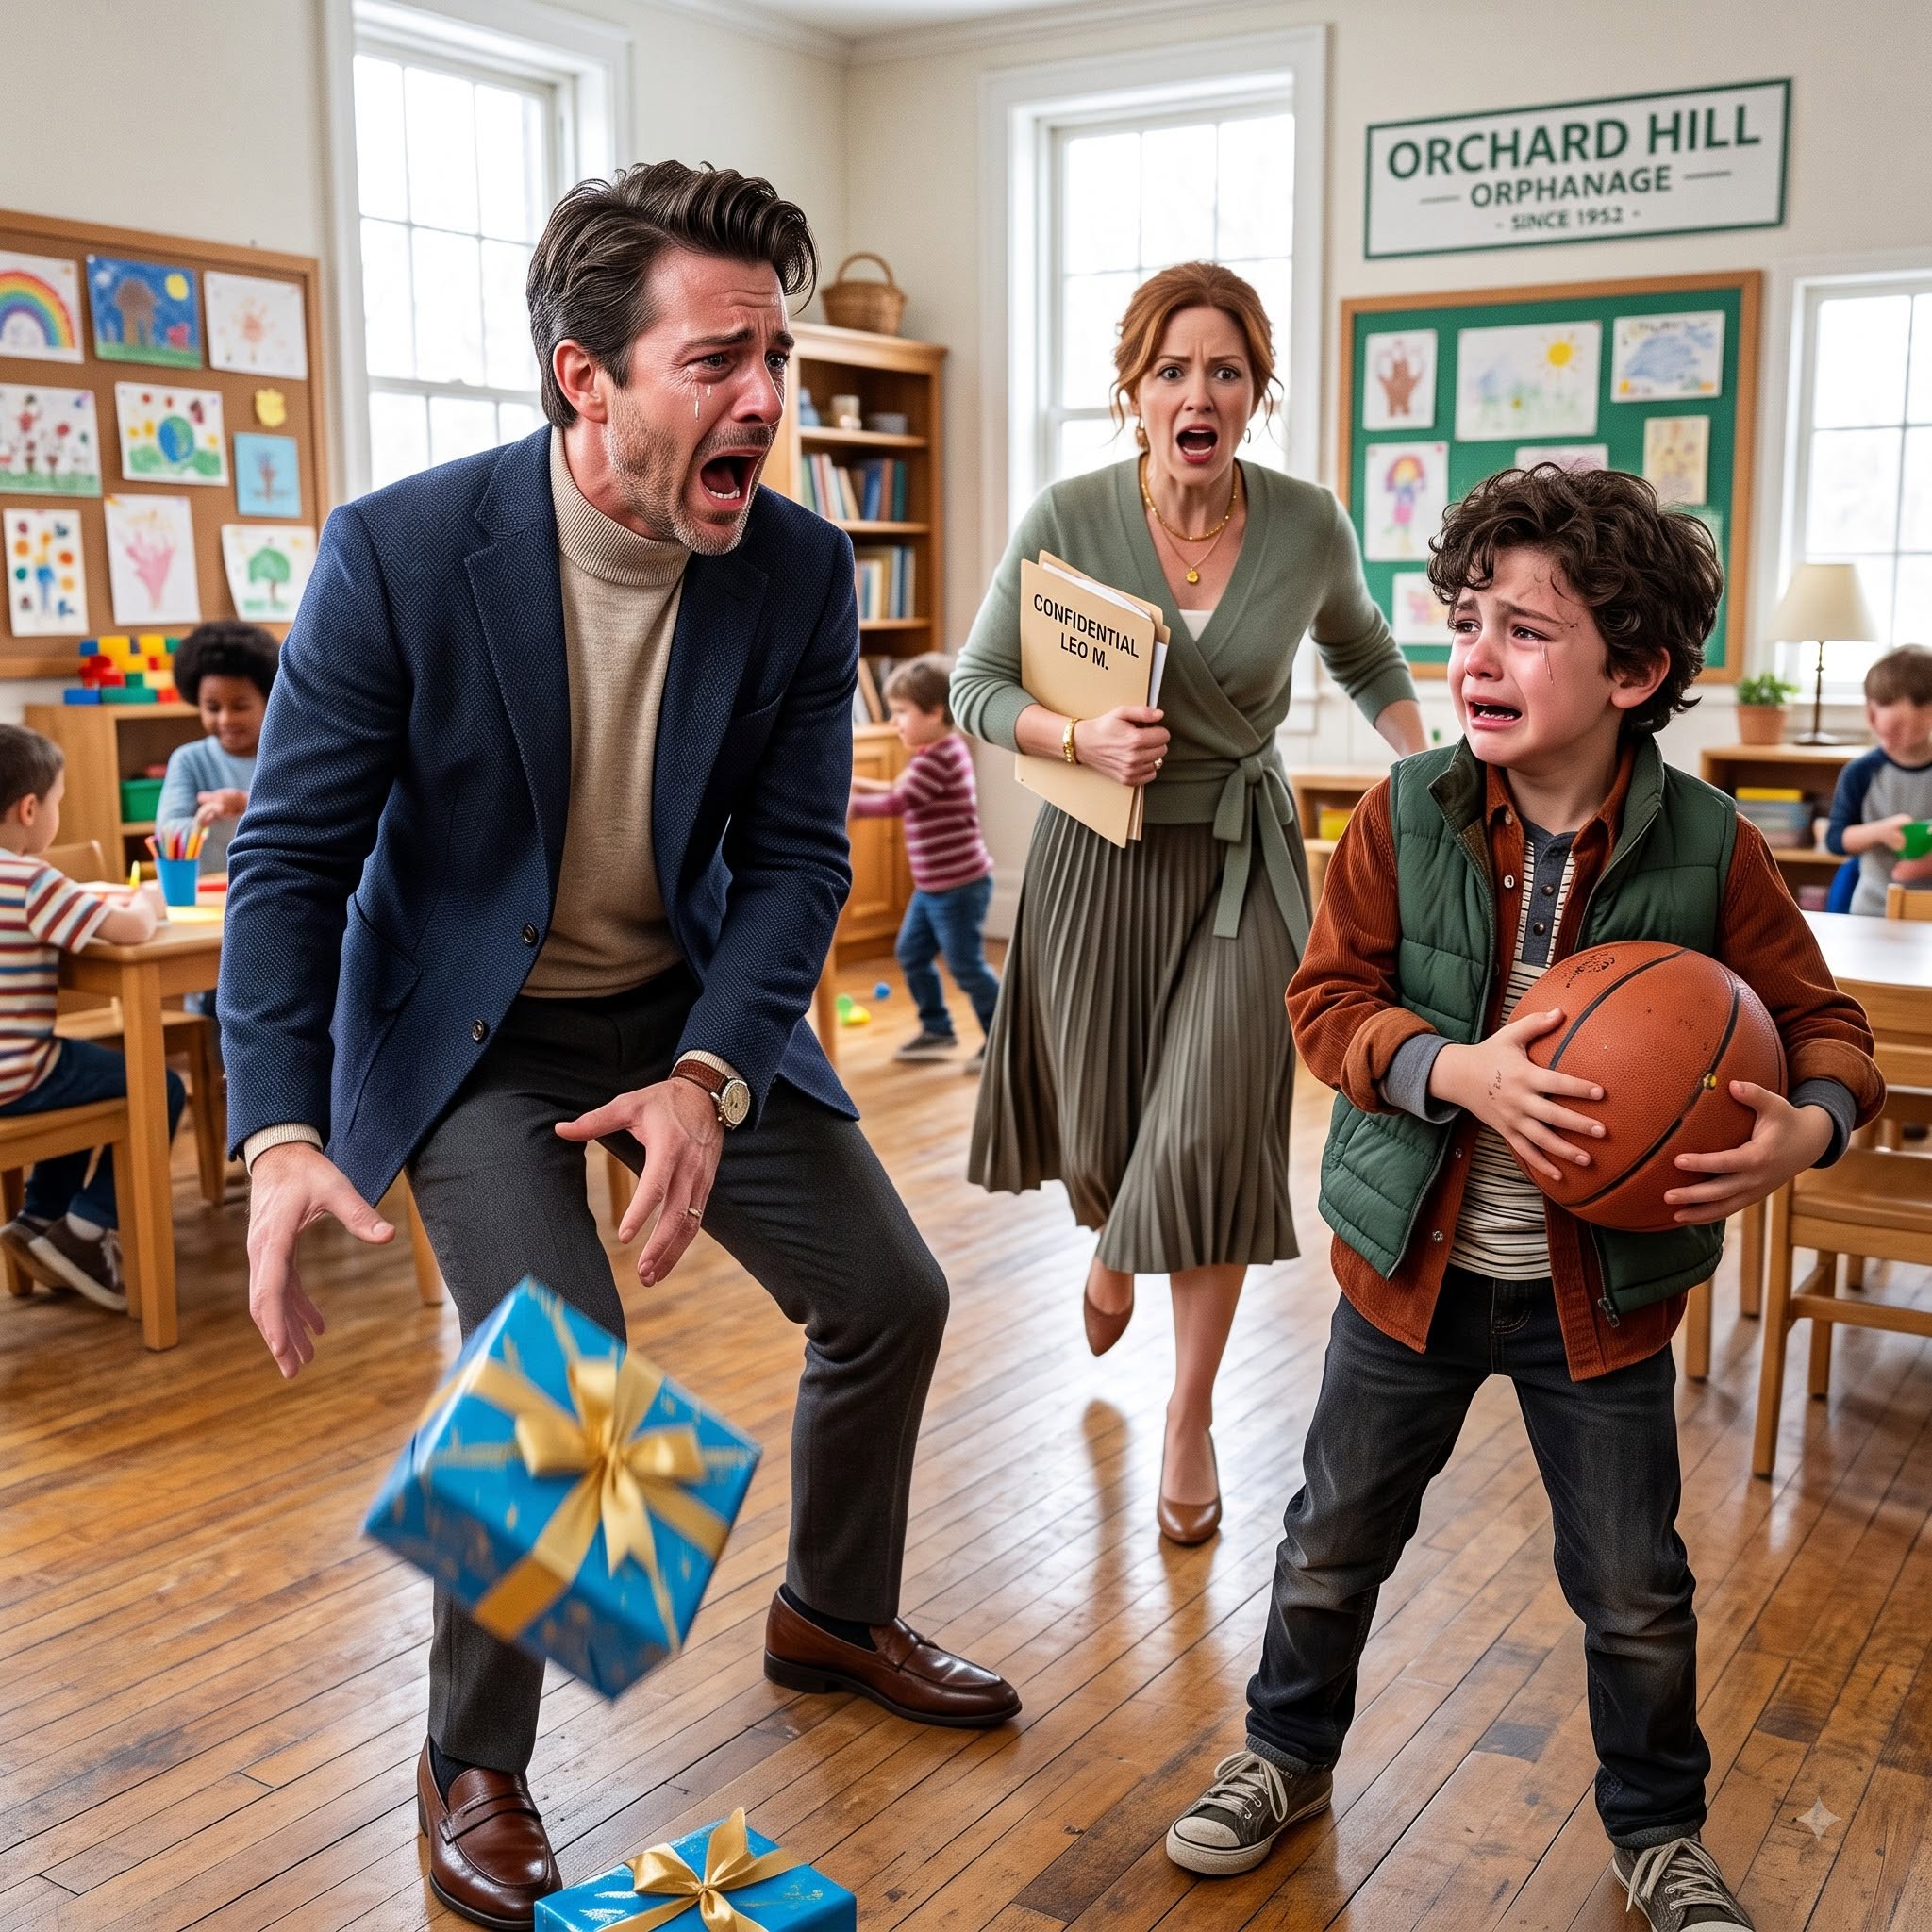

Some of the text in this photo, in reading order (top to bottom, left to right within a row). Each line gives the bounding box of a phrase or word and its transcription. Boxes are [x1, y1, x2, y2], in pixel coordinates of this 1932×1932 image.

[1388, 105, 1761, 179] ORCHARD HILL
[1471, 166, 1672, 208] ORPHANAGE
[1511, 207, 1623, 231] SINCE 1952
[1034, 593, 1140, 658] CONFIDENTIAL
[1060, 632, 1108, 671] LEO M.
